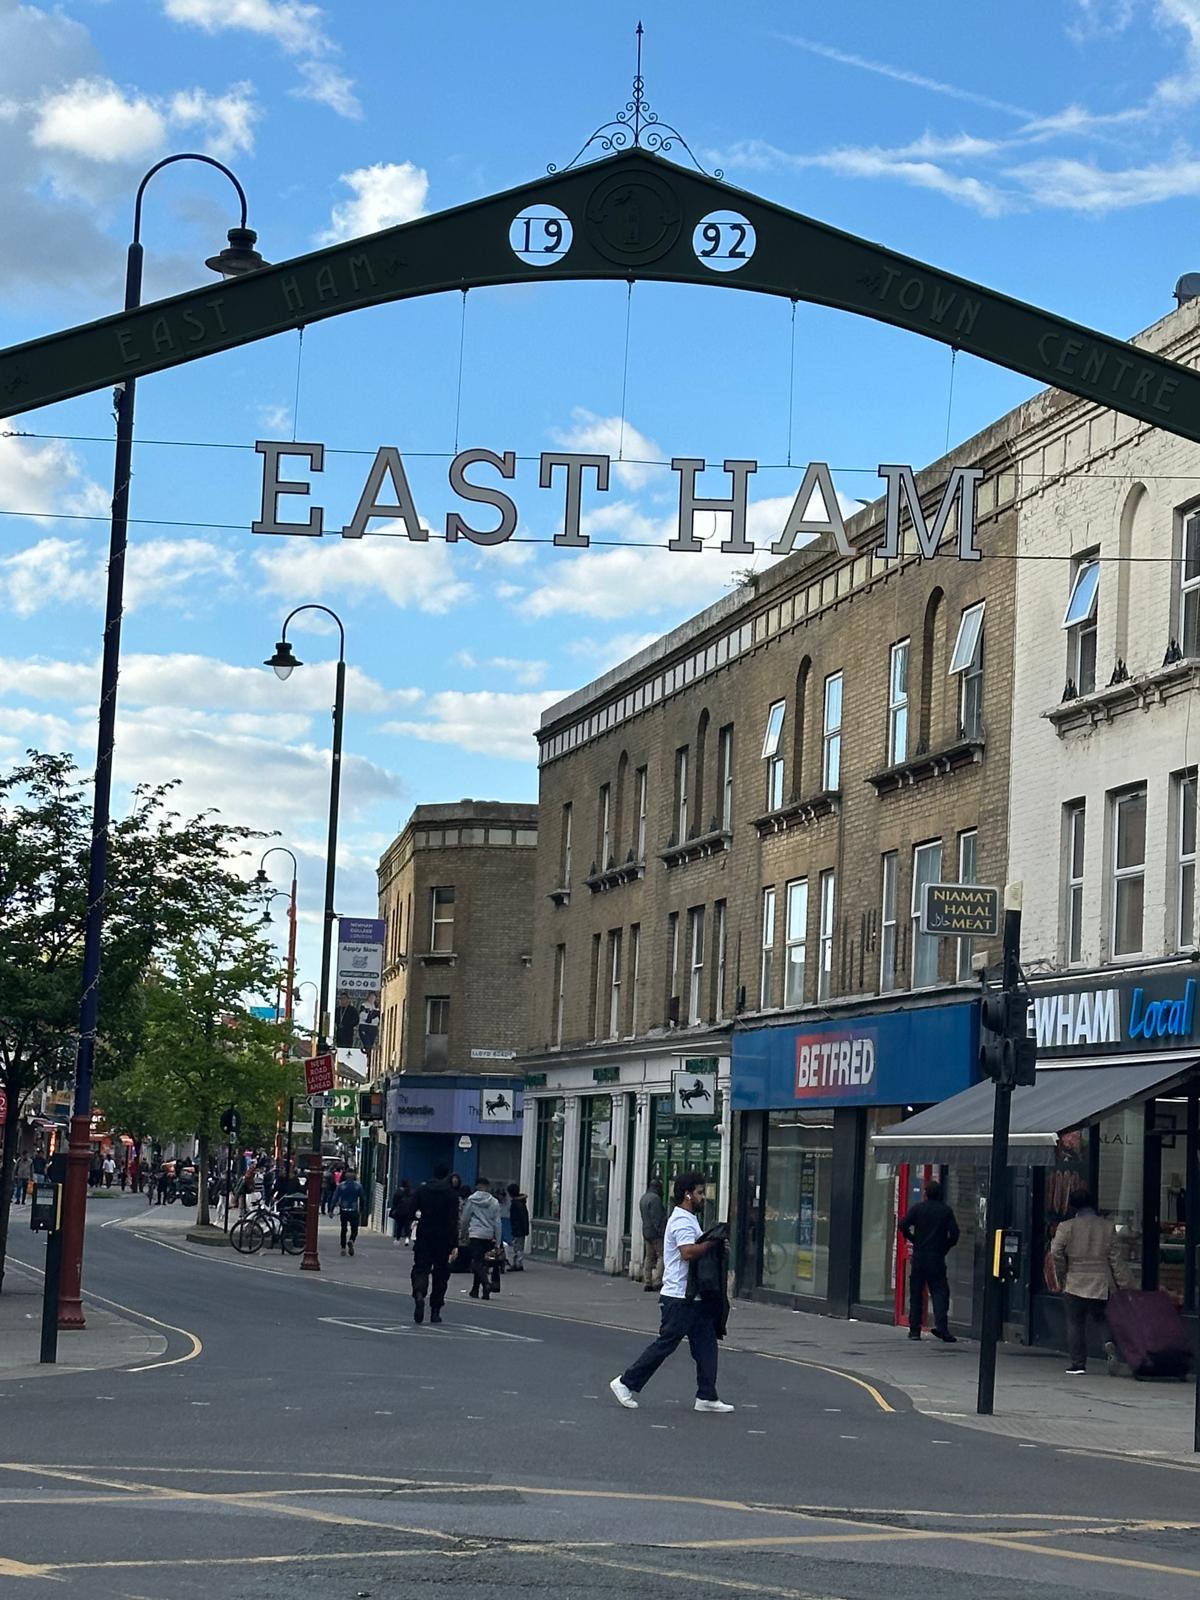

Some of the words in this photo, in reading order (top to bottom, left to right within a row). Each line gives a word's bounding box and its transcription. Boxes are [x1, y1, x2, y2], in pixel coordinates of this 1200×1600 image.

[523, 218, 563, 252] 19
[700, 223, 747, 257] 92
[115, 298, 230, 364] EAST
[280, 252, 378, 314] HAM
[878, 264, 981, 337] TOWN
[1037, 331, 1179, 414] CENTRE
[252, 440, 609, 546] EAST
[669, 458, 985, 560] HAM
[934, 890, 993, 903] NIAMAT
[944, 904, 992, 916] HALAL
[952, 918, 992, 930] MEAT
[343, 945, 361, 953] Apply
[1026, 988, 1121, 1048] EWHAM
[1128, 976, 1197, 1039] Local
[310, 1059, 326, 1068] NEW
[798, 1038, 875, 1088] BETFRED
[310, 1066, 328, 1075] ROAD
[308, 1072, 331, 1084] LAYOUT
[310, 1080, 332, 1091] AHEAD
